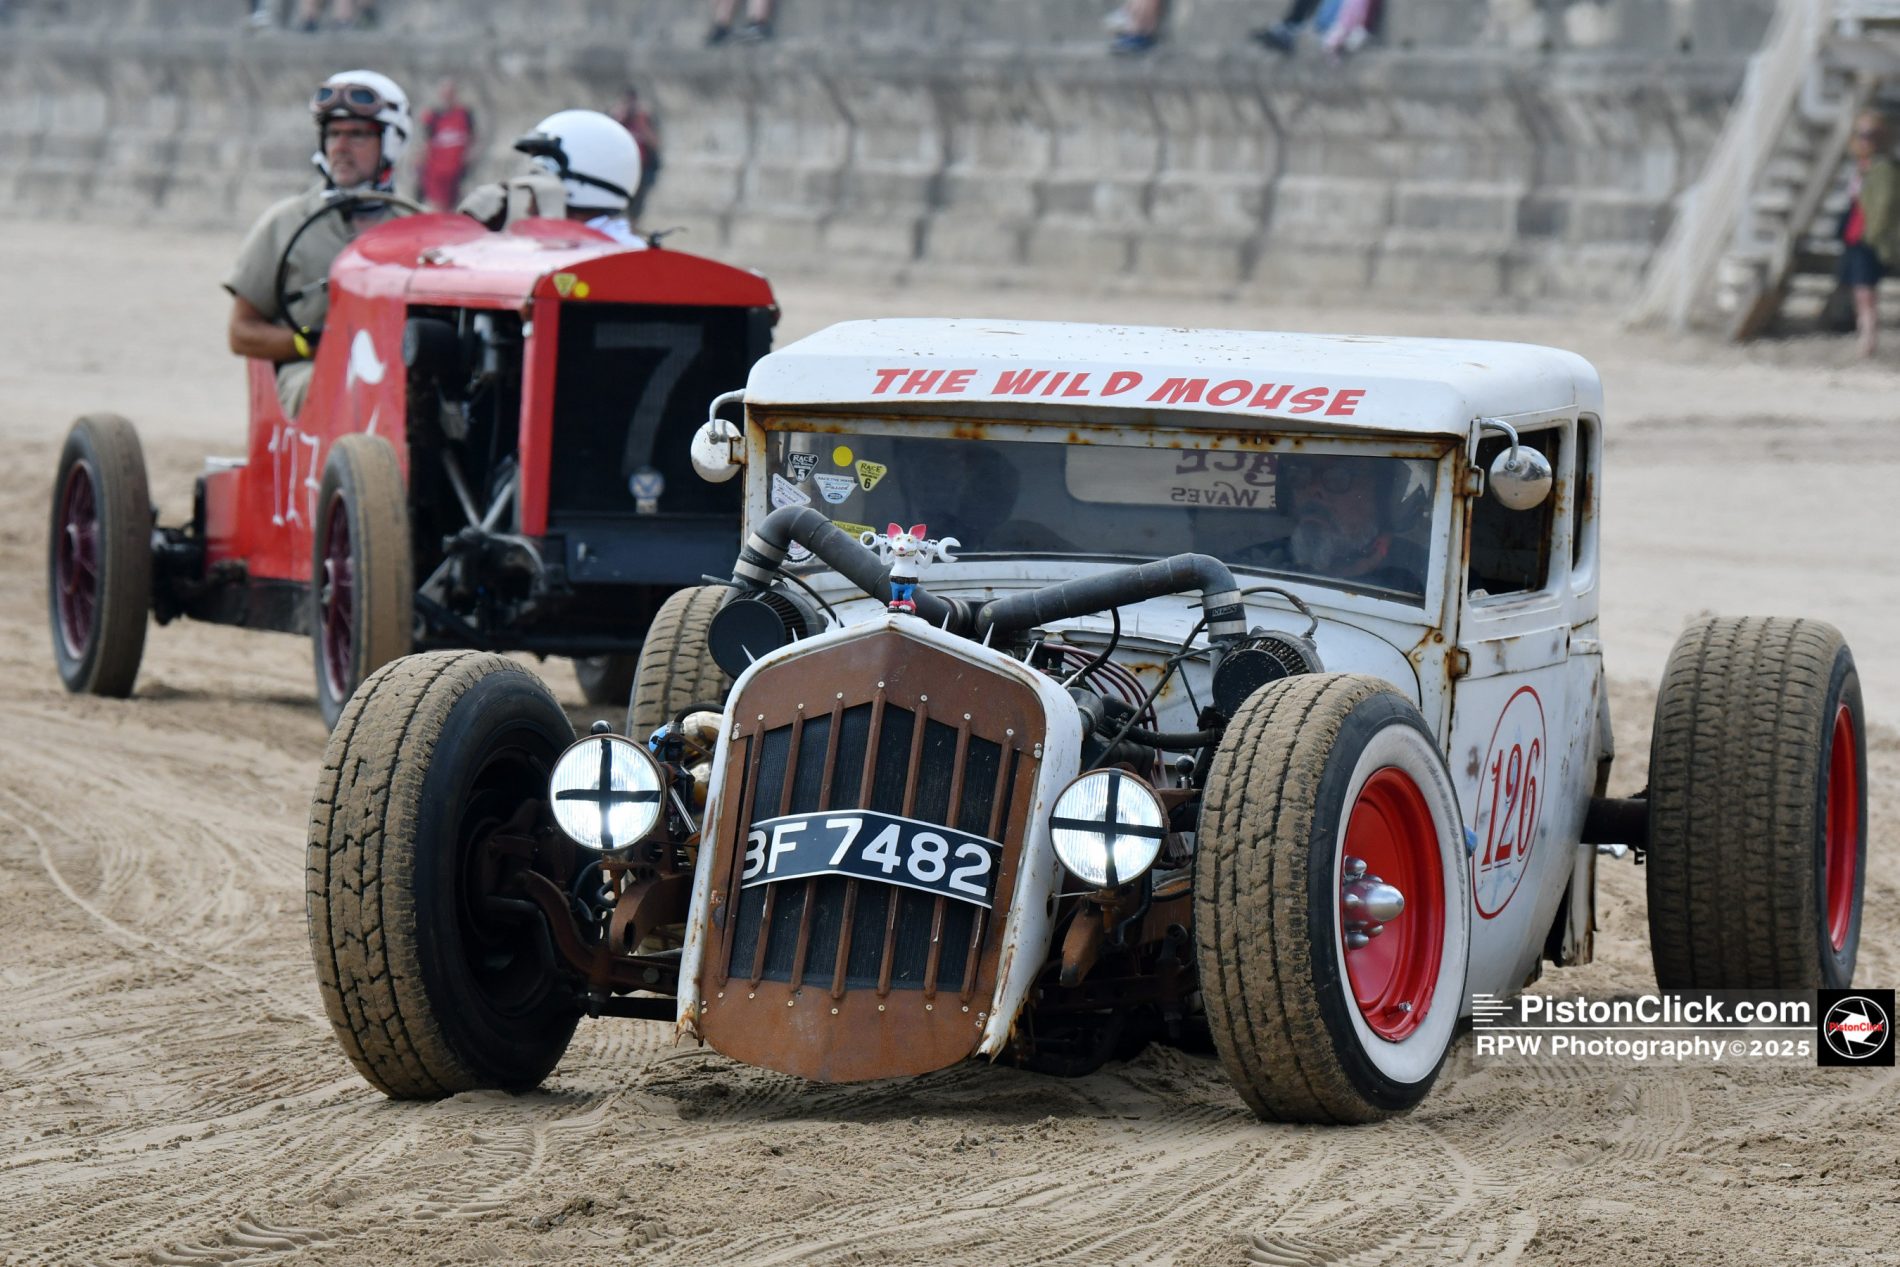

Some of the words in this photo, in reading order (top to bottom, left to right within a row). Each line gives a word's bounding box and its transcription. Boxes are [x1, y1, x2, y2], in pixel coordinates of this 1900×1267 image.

[595, 322, 704, 479] 7
[874, 368, 977, 395] THE
[991, 368, 1143, 397] WILD
[1147, 377, 1366, 417] MOUSE
[792, 454, 814, 464] RACE
[861, 463, 882, 473] RACE
[797, 469, 806, 481] 5
[864, 478, 872, 489] 6
[1481, 738, 1541, 867] 126
[825, 817, 992, 897] 7482
